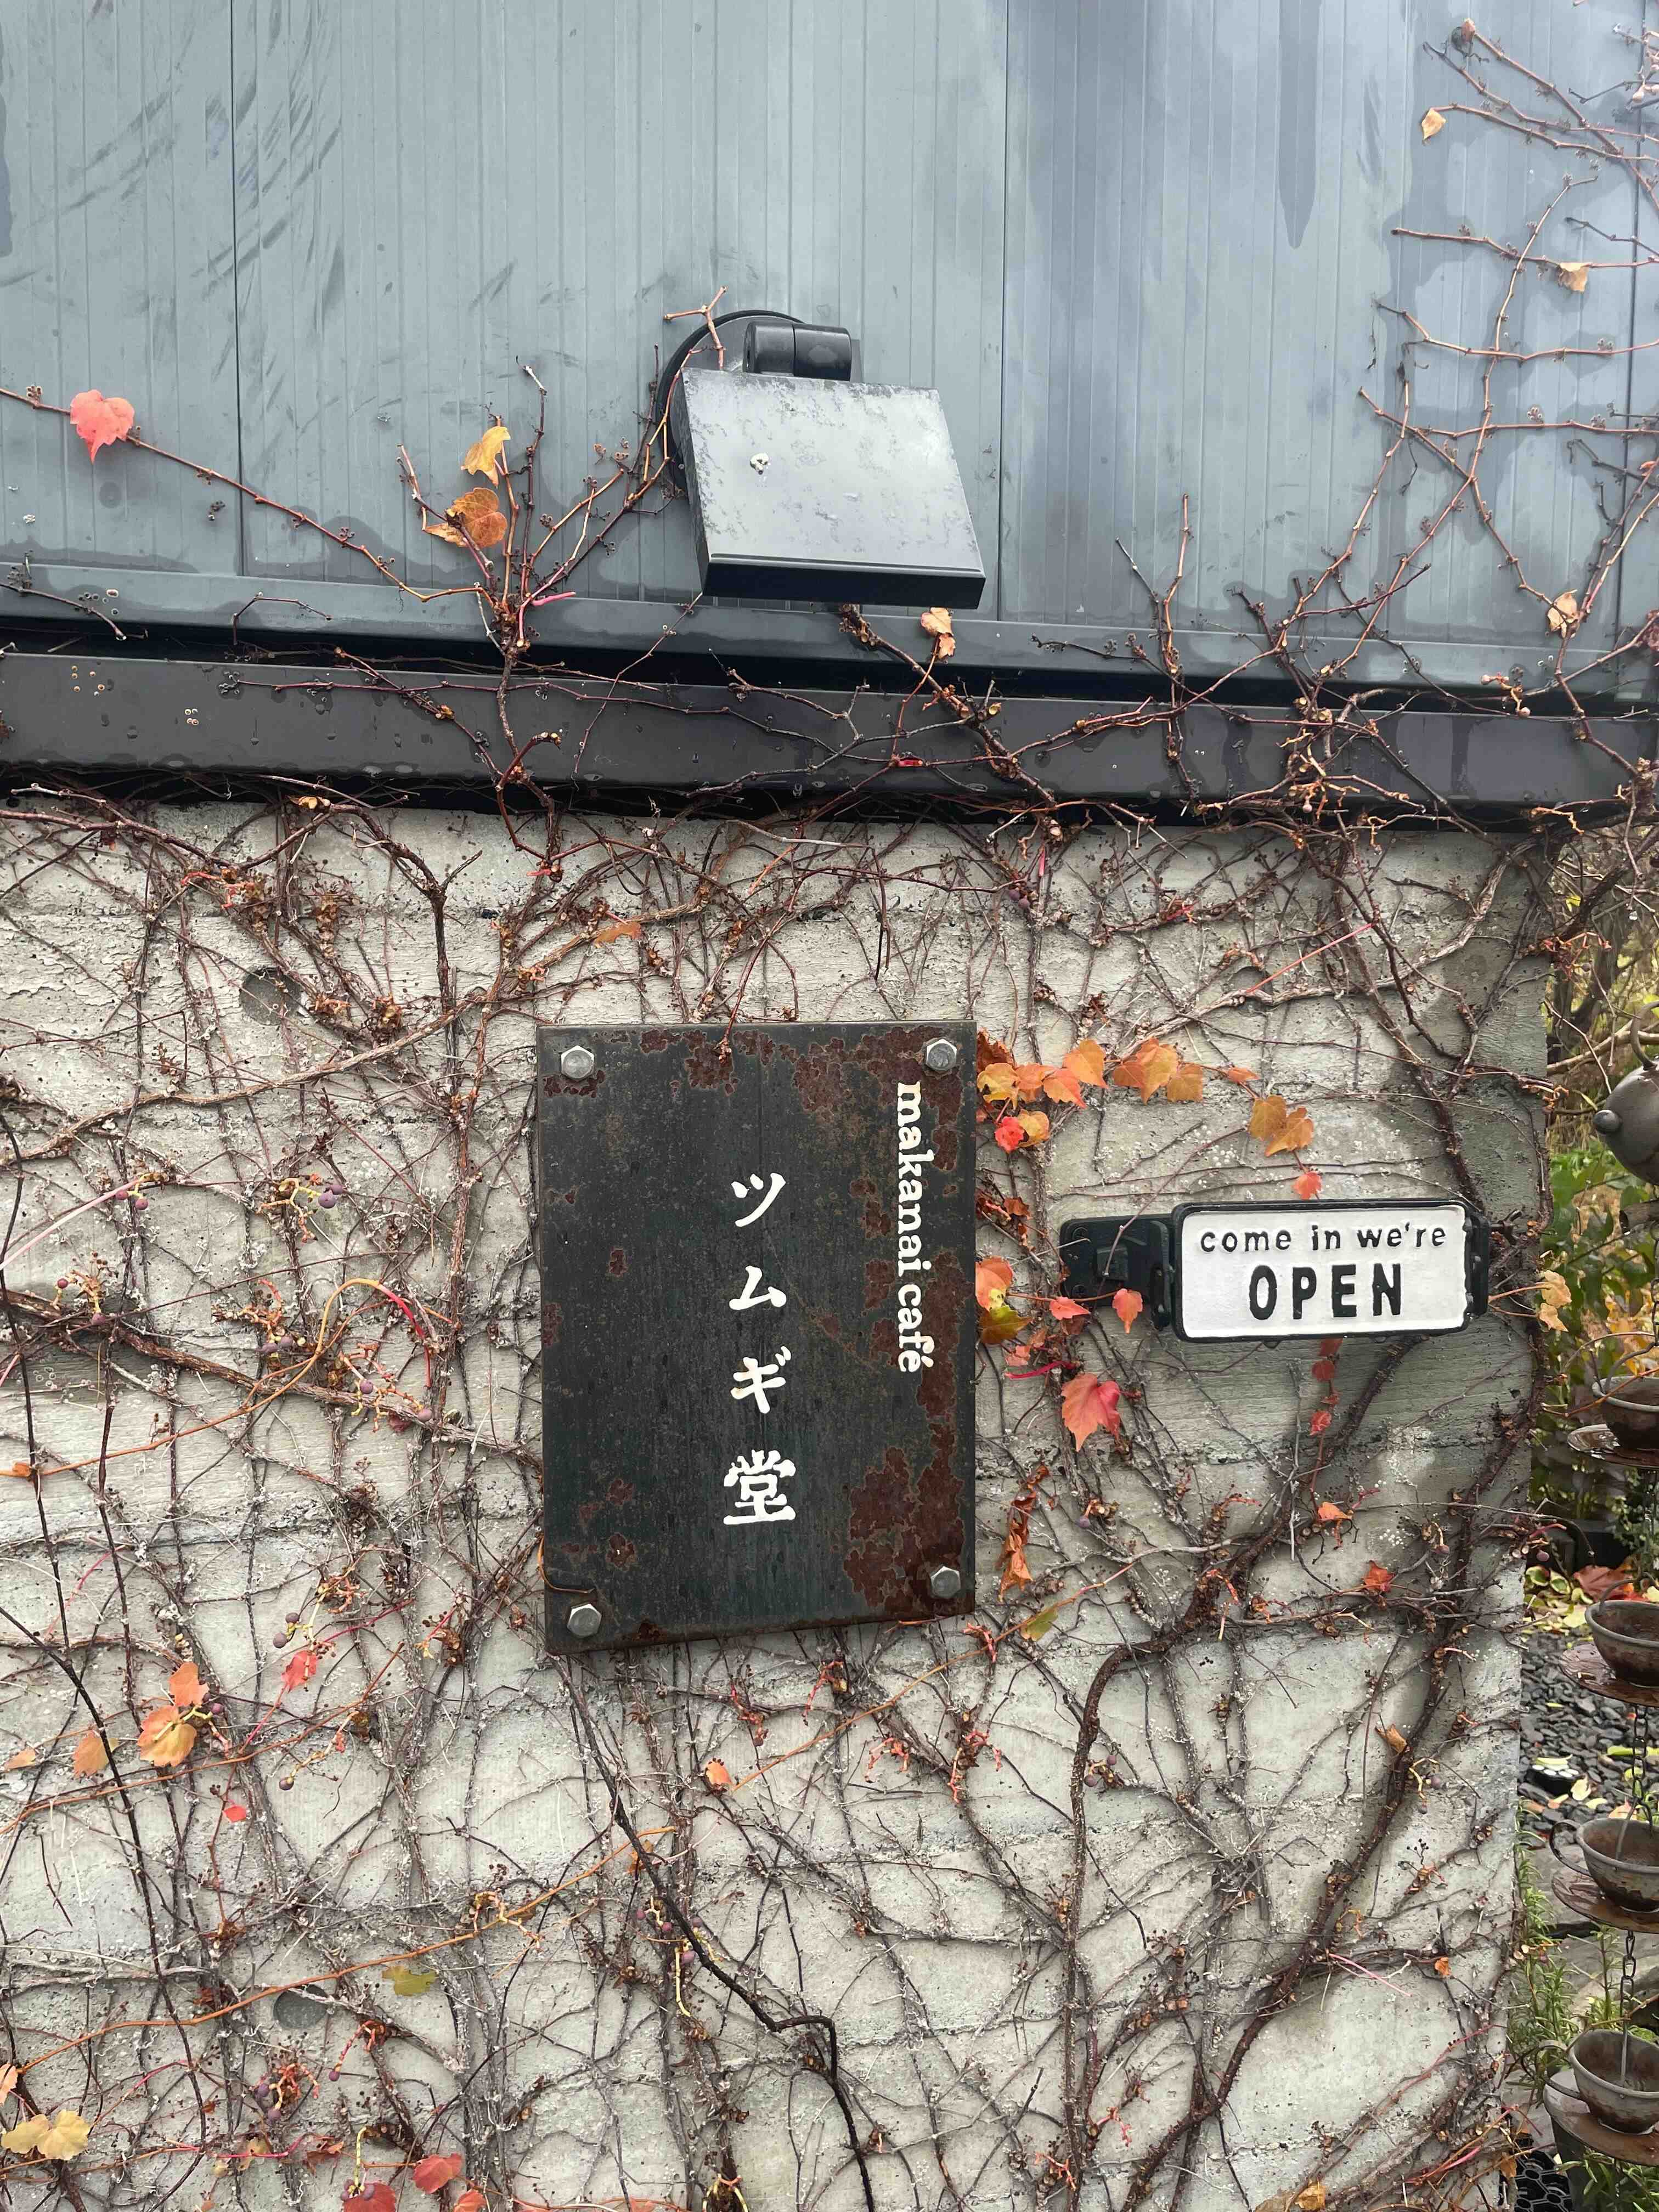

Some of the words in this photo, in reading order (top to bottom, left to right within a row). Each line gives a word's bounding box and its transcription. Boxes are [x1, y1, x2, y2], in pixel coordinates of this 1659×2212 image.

[897, 1081, 934, 1277] makanai
[1200, 1230, 1292, 1253] come
[1311, 1224, 1341, 1251] in
[1357, 1221, 1446, 1249] we're
[897, 1283, 934, 1373] café
[1248, 1263, 1402, 1321] OPEN
[723, 1172, 796, 1525] ツムギ堂
